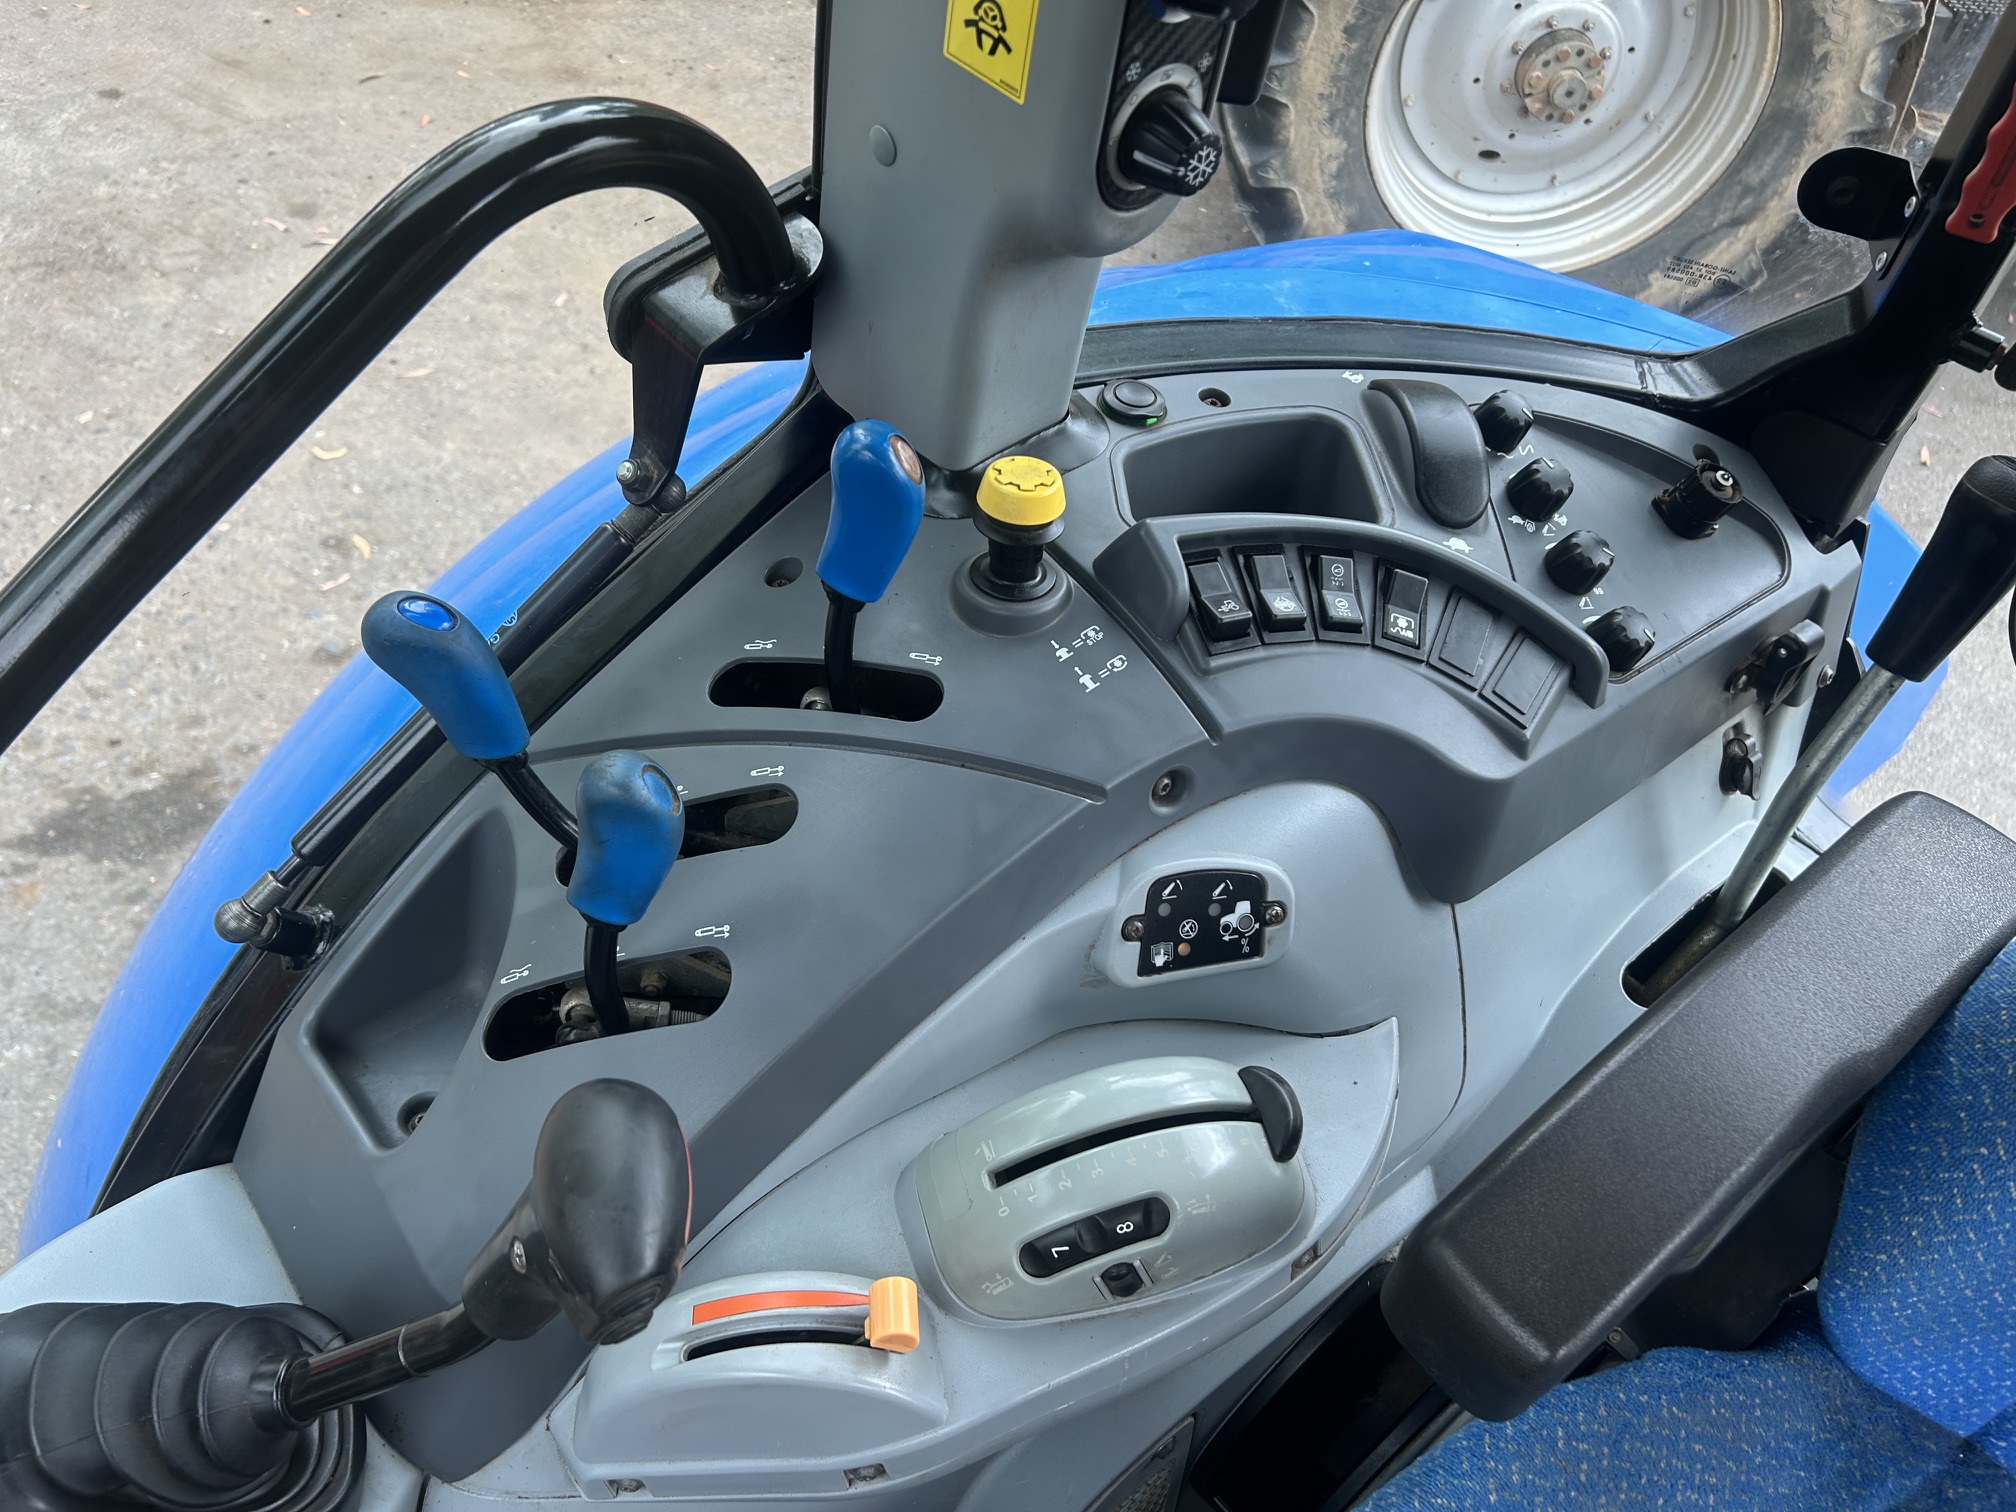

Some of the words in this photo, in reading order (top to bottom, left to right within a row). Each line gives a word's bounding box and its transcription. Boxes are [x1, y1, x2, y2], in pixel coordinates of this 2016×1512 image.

[1086, 631, 1104, 646] STOP
[1058, 1178, 1072, 1190] 2
[1091, 1167, 1105, 1179] 3
[1050, 1246, 1069, 1258] 7
[1116, 1221, 1134, 1234] 8
